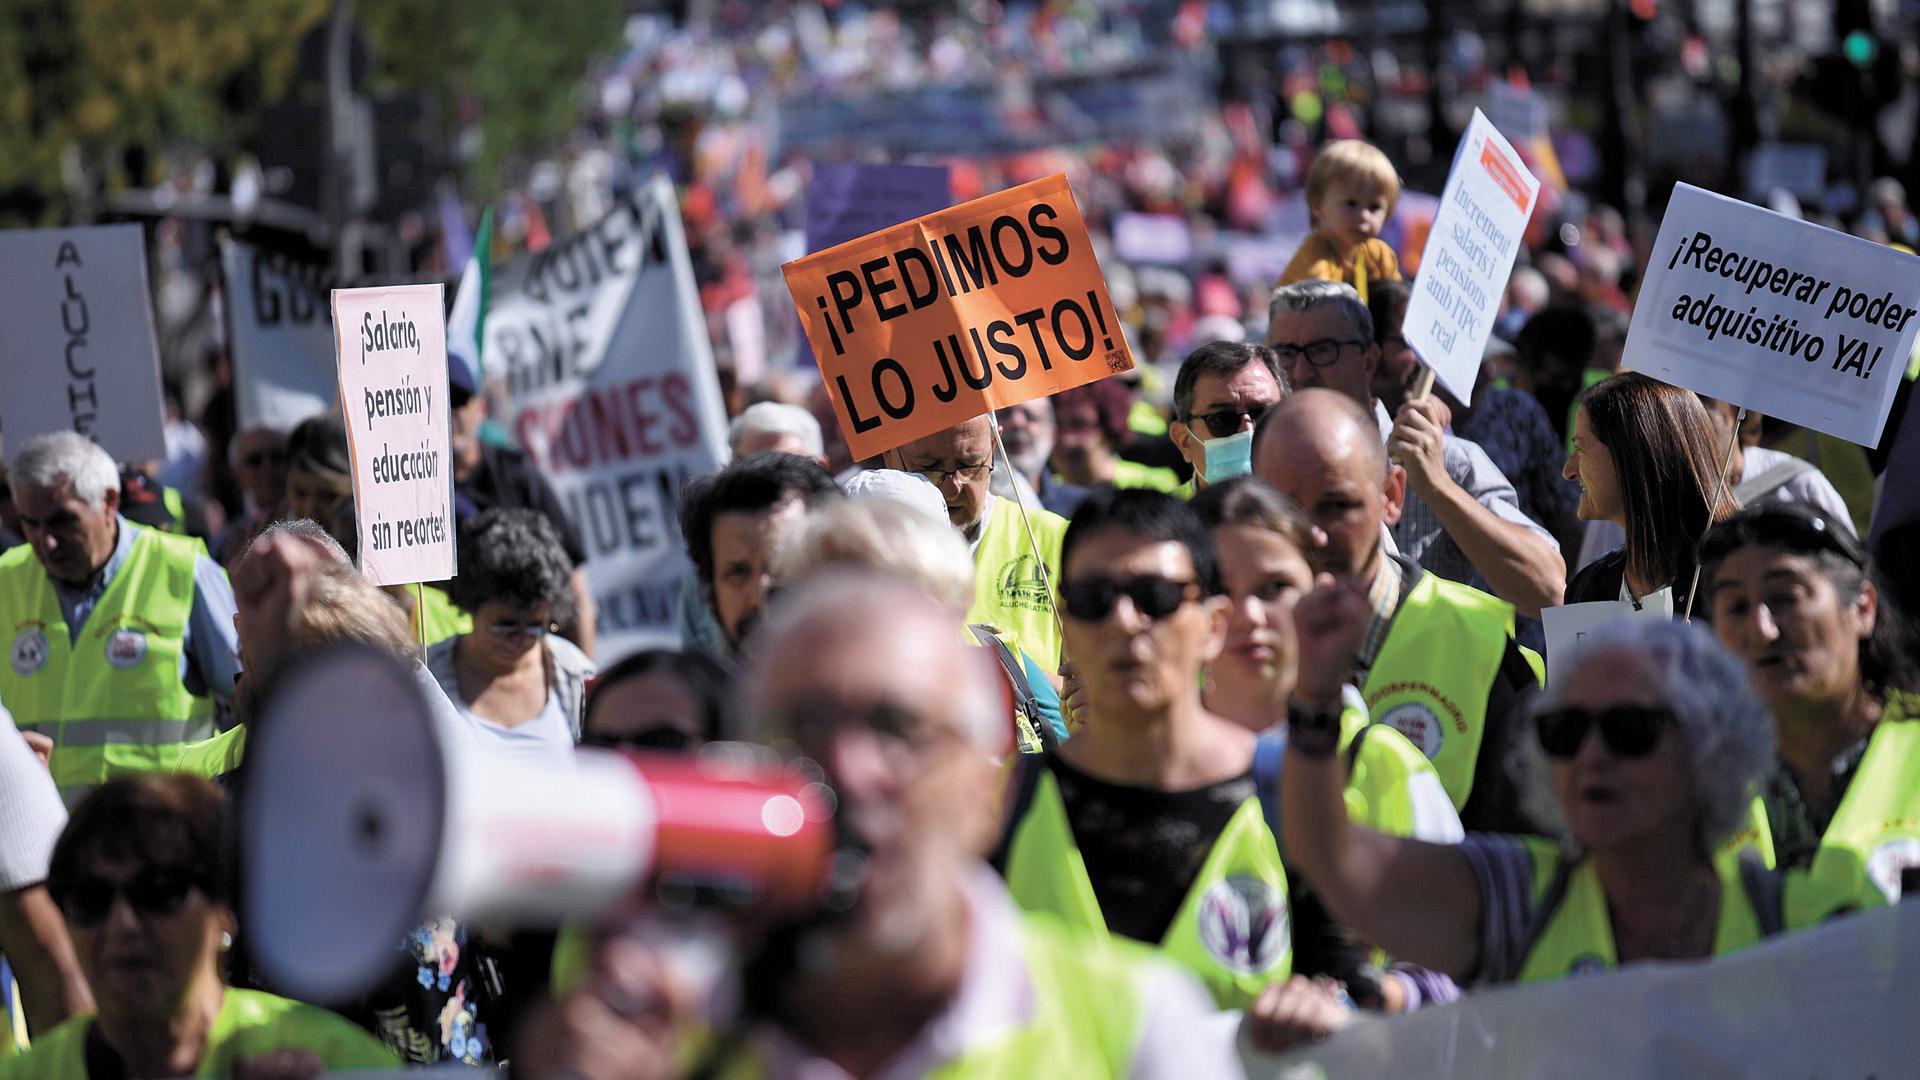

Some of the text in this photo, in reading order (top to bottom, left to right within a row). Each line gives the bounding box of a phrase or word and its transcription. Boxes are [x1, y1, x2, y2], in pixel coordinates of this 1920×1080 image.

[1451, 222, 1489, 272] salaris
[1454, 180, 1512, 258] Increment
[817, 203, 1069, 355] ¡PEDIMOS
[1426, 275, 1453, 309] amb
[1436, 248, 1487, 311] pensions
[1668, 231, 1917, 333] ¡Recuperar poder
[361, 310, 420, 365] ¡Salario,
[836, 290, 1114, 434] LO JUSTO!
[1430, 319, 1458, 353] real
[1672, 293, 1883, 380] adquisitivo YA!
[364, 375, 432, 431] pensión y
[372, 438, 438, 484] educación
[371, 502, 447, 551] sin recortes!
